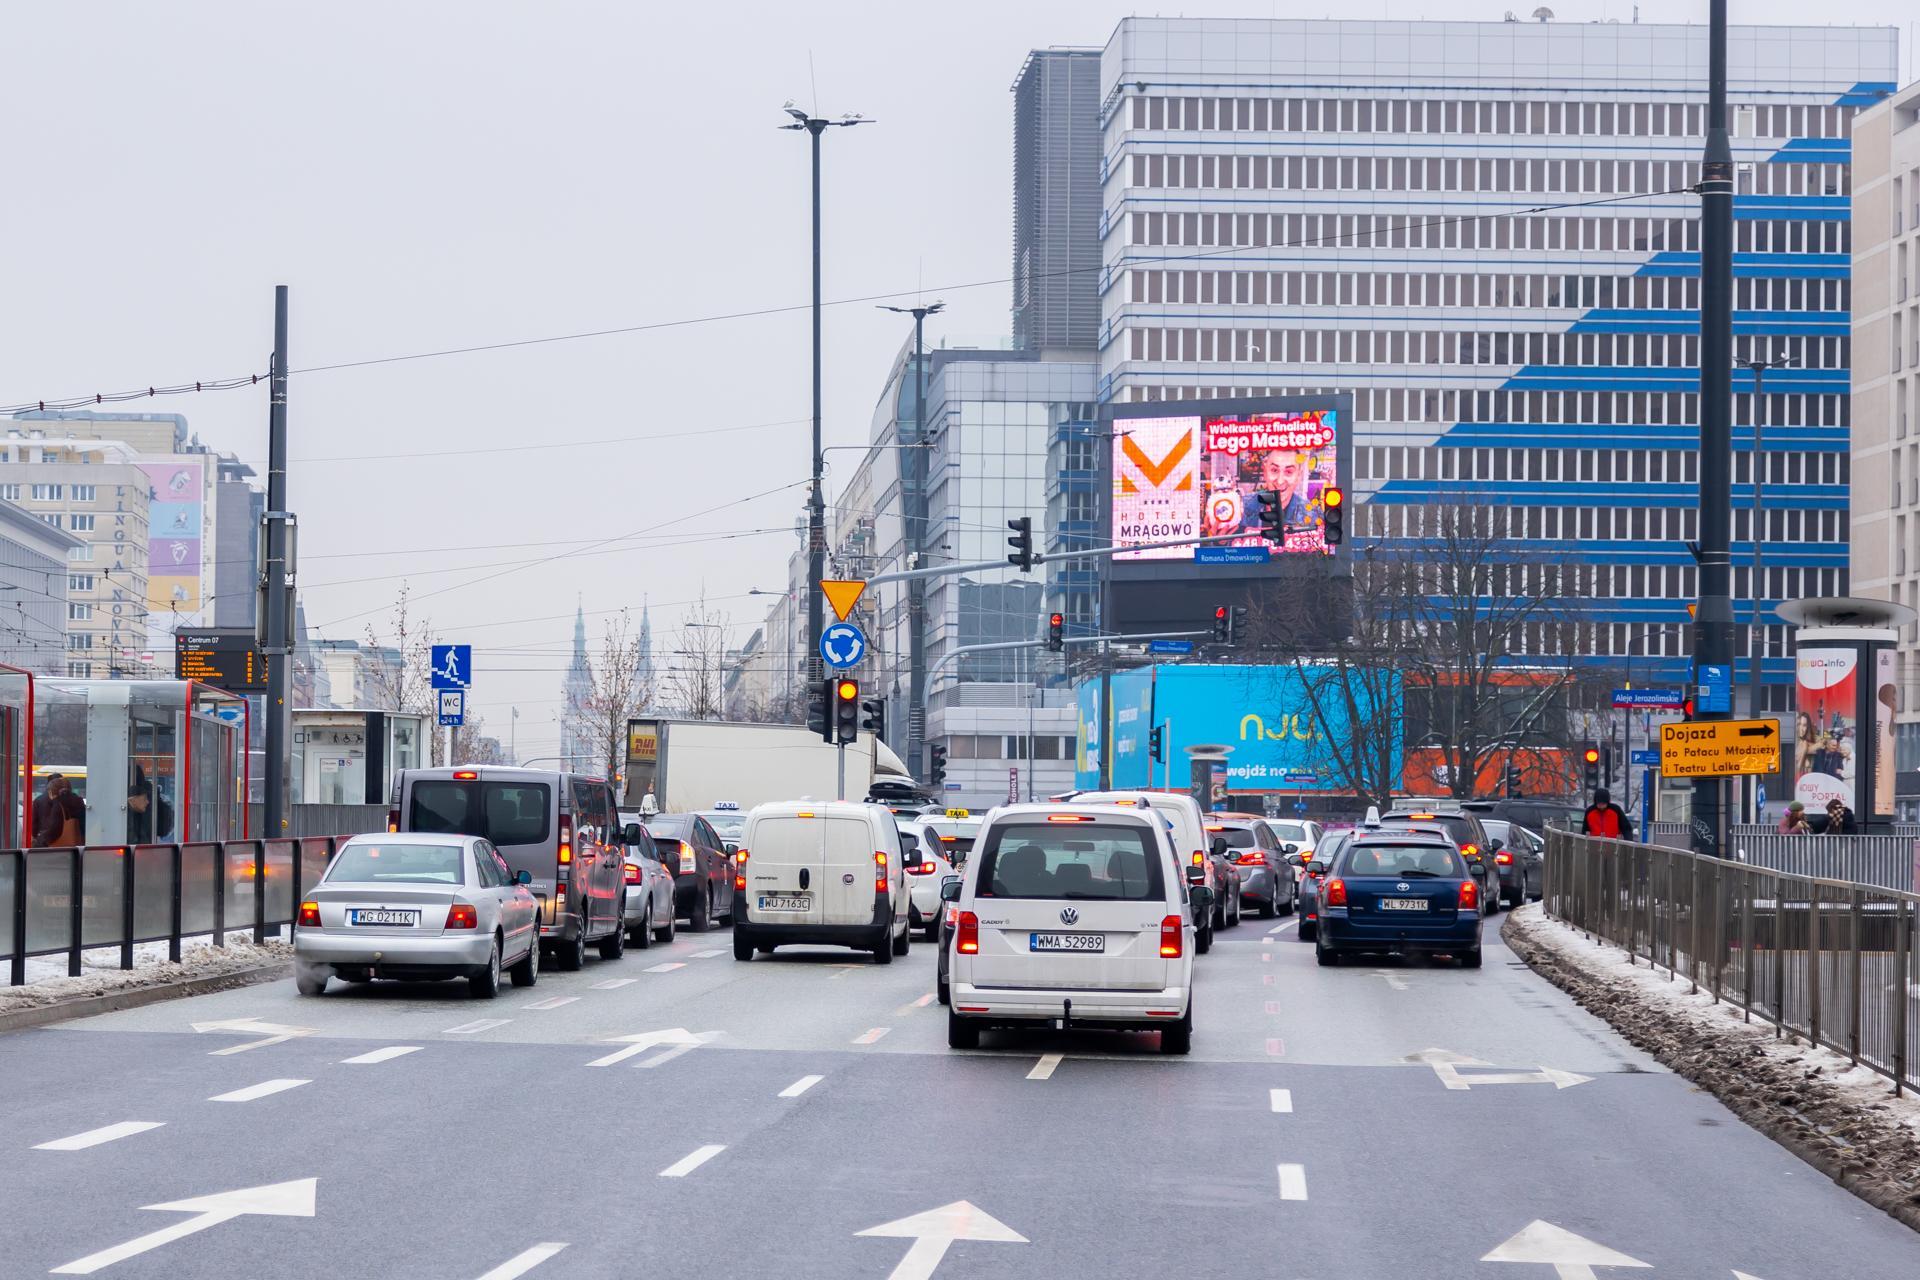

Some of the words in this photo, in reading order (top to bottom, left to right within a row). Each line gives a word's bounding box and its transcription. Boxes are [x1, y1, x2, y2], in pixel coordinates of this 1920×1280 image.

[1209, 423, 1264, 434] Wielkanoc
[1273, 421, 1316, 433] finalistą
[1209, 434, 1249, 454] Lego
[1121, 511, 1191, 521] HOTEL
[114, 486, 125, 570] LINGUA
[1121, 523, 1192, 540] MRĄGOWO
[1225, 554, 1263, 563] Dmowskiego
[112, 589, 123, 644] NOVA
[443, 697, 459, 707] WC
[1615, 694, 1633, 703] Aleje
[1634, 694, 1679, 703] Jerozolimskie
[1665, 726, 1716, 743] Dojazd
[1665, 748, 1678, 758] do
[1684, 747, 1720, 757] Pałacu
[1725, 744, 1776, 756] Młodzieży
[1226, 764, 1266, 780] wejdź
[1665, 764, 1669, 773] i
[1673, 763, 1706, 773] Teatru
[1712, 762, 1740, 772] Lalka
[1811, 792, 1846, 801] PORTAL
[765, 899, 778, 908] WU
[780, 899, 808, 909] 7163C
[1383, 899, 1396, 909] WL
[1399, 899, 1427, 909] 9731K
[359, 911, 374, 922] WG
[377, 911, 411, 923] 0211K
[1037, 935, 1061, 948] WMA
[1064, 936, 1103, 949] 52989
